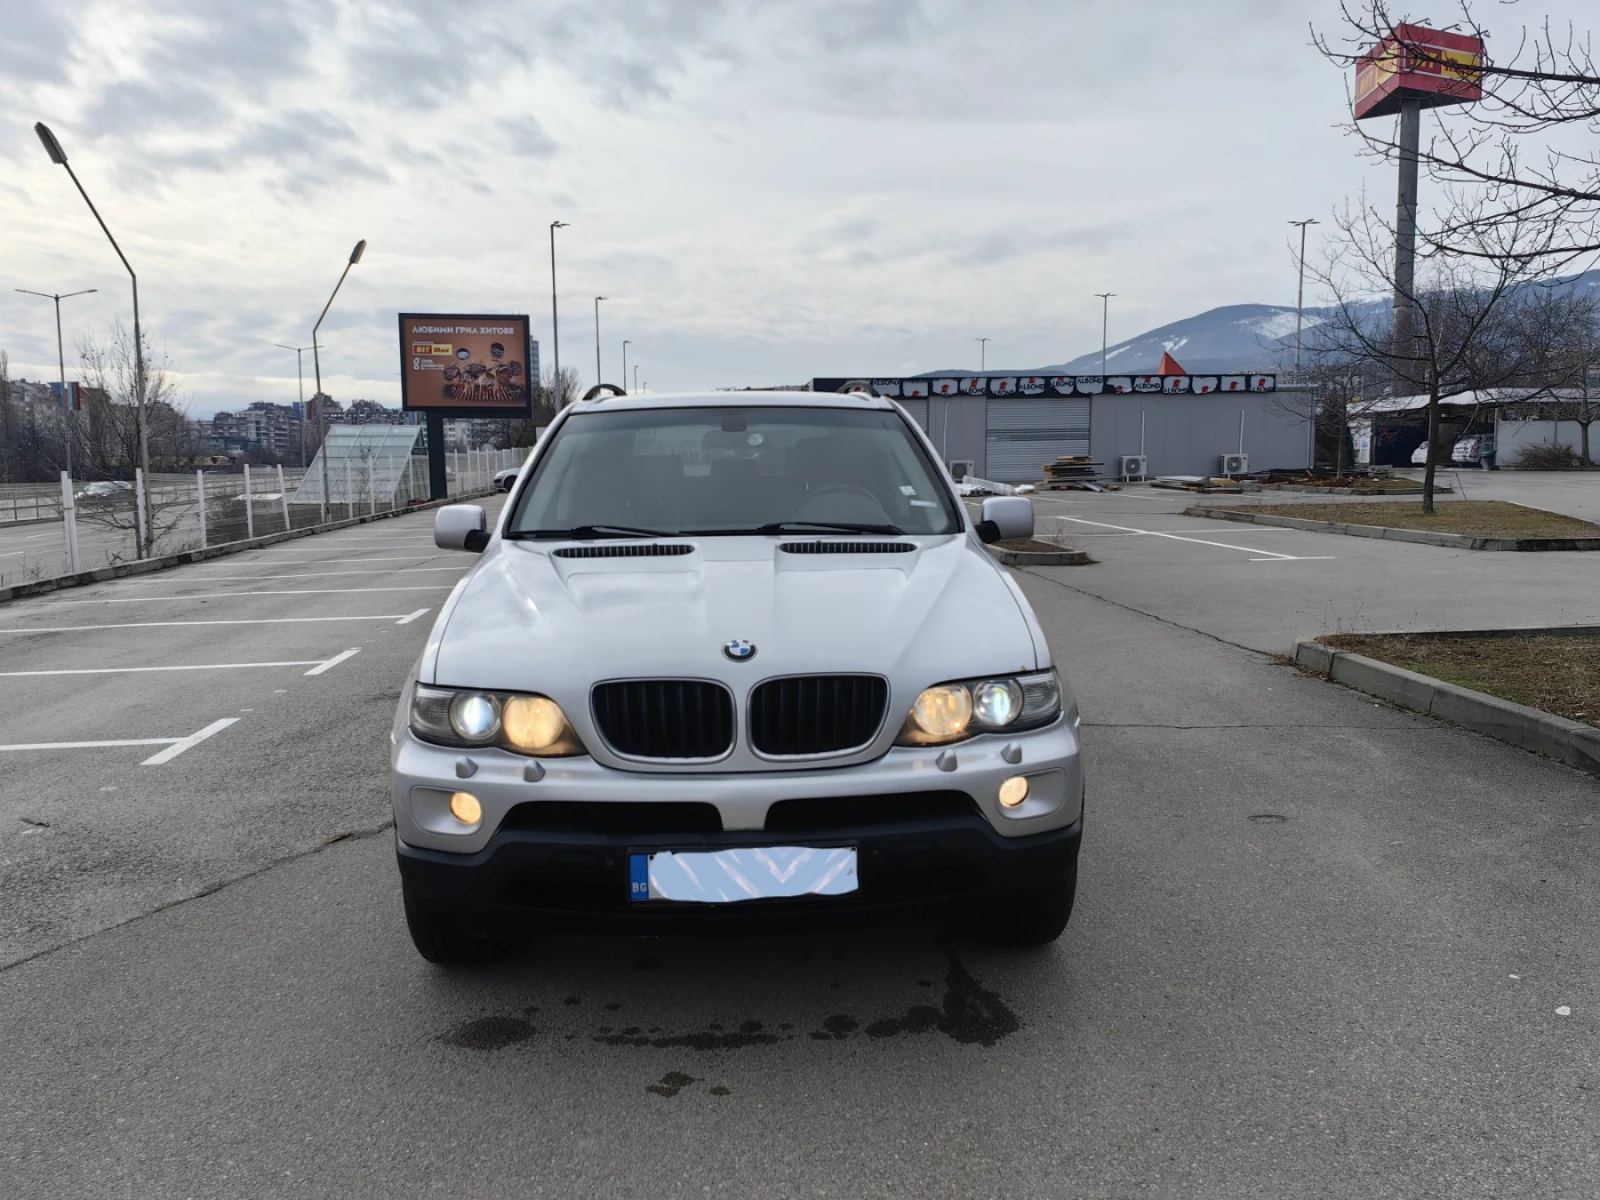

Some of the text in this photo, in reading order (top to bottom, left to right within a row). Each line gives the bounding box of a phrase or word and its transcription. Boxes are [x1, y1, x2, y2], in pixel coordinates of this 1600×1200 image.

[412, 326, 453, 334] ЛЮБИМИ
[479, 327, 514, 335] ХИТОВЕ
[1077, 376, 1102, 384] ALBOND
[1134, 382, 1160, 390] ALBOND
[632, 882, 647, 893] BG
